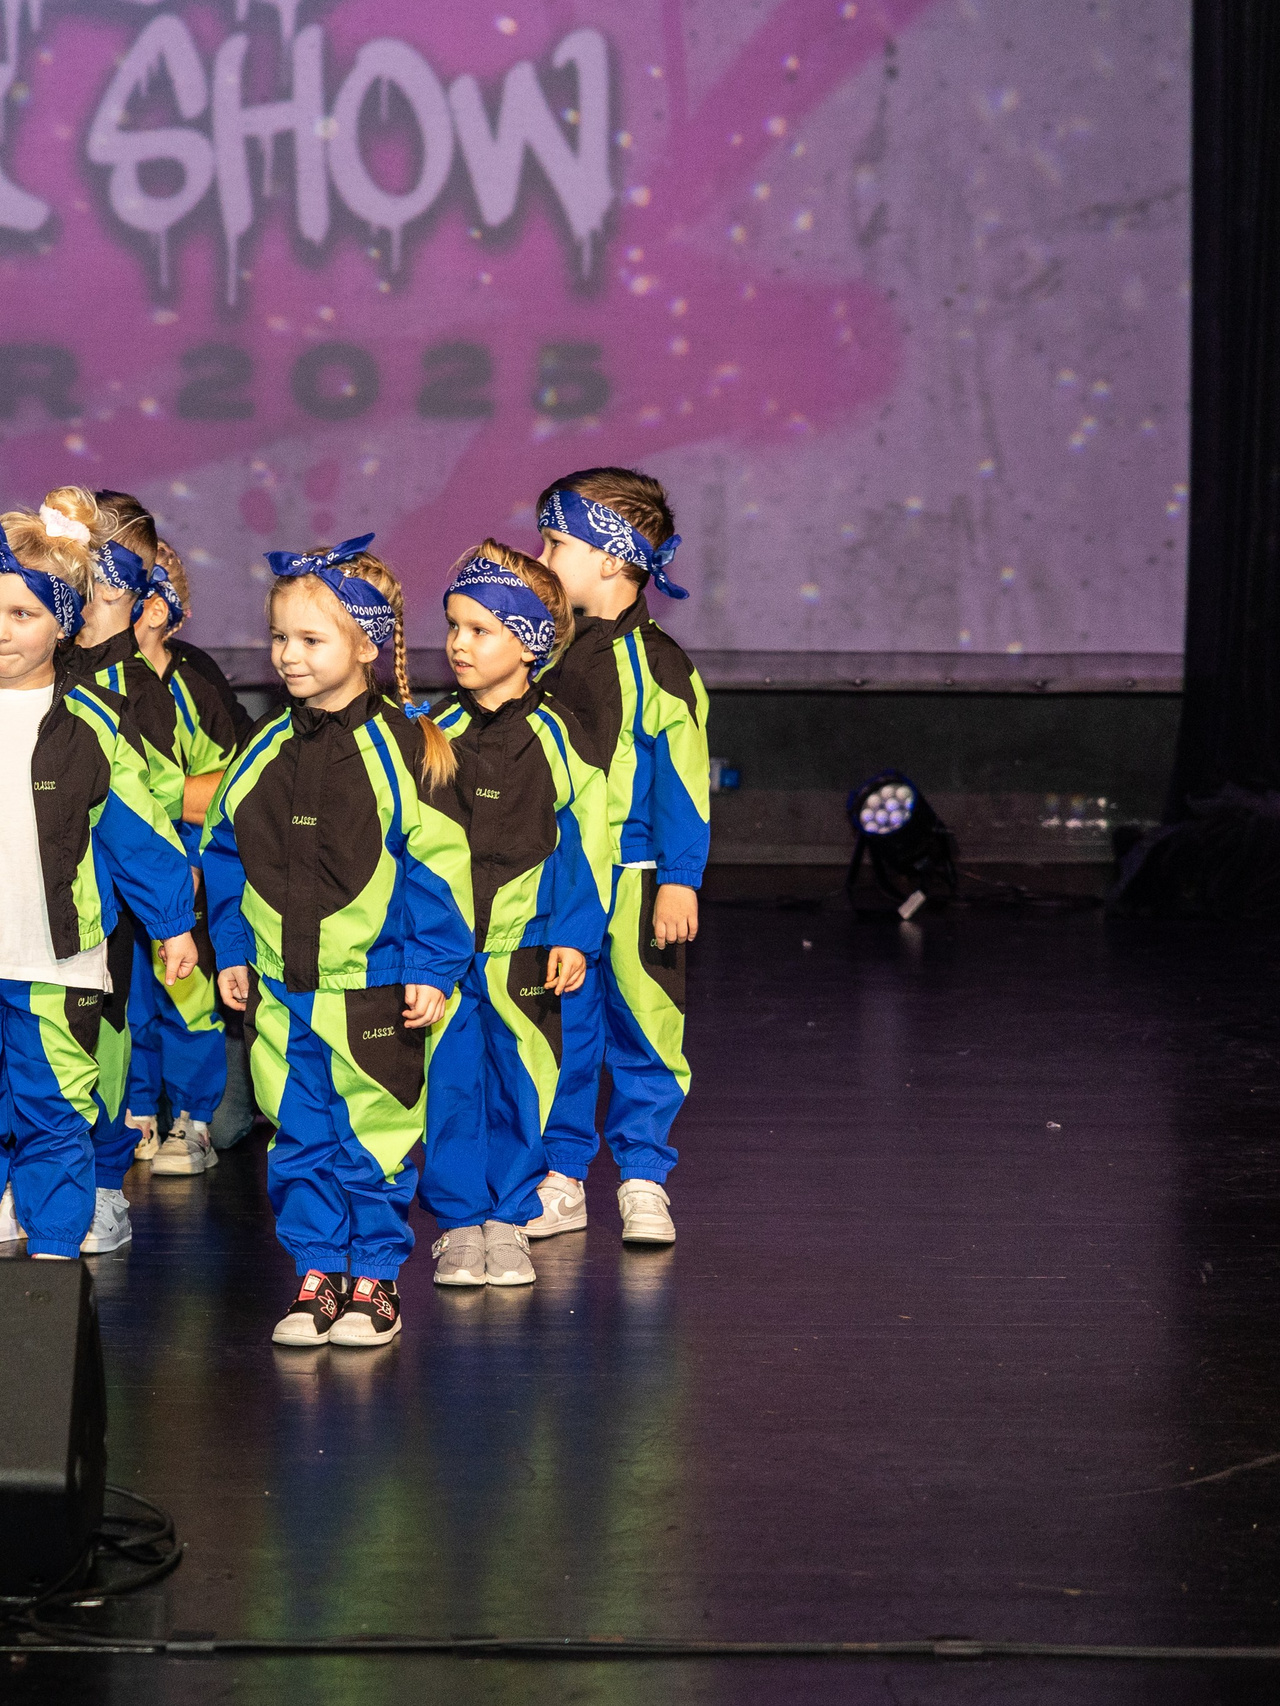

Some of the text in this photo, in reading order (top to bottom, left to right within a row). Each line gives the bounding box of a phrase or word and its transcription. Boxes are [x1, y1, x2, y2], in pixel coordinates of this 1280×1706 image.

[87, 14, 613, 285] SHOW
[176, 342, 612, 421] 2025
[362, 1025, 396, 1040] CLASSIC
